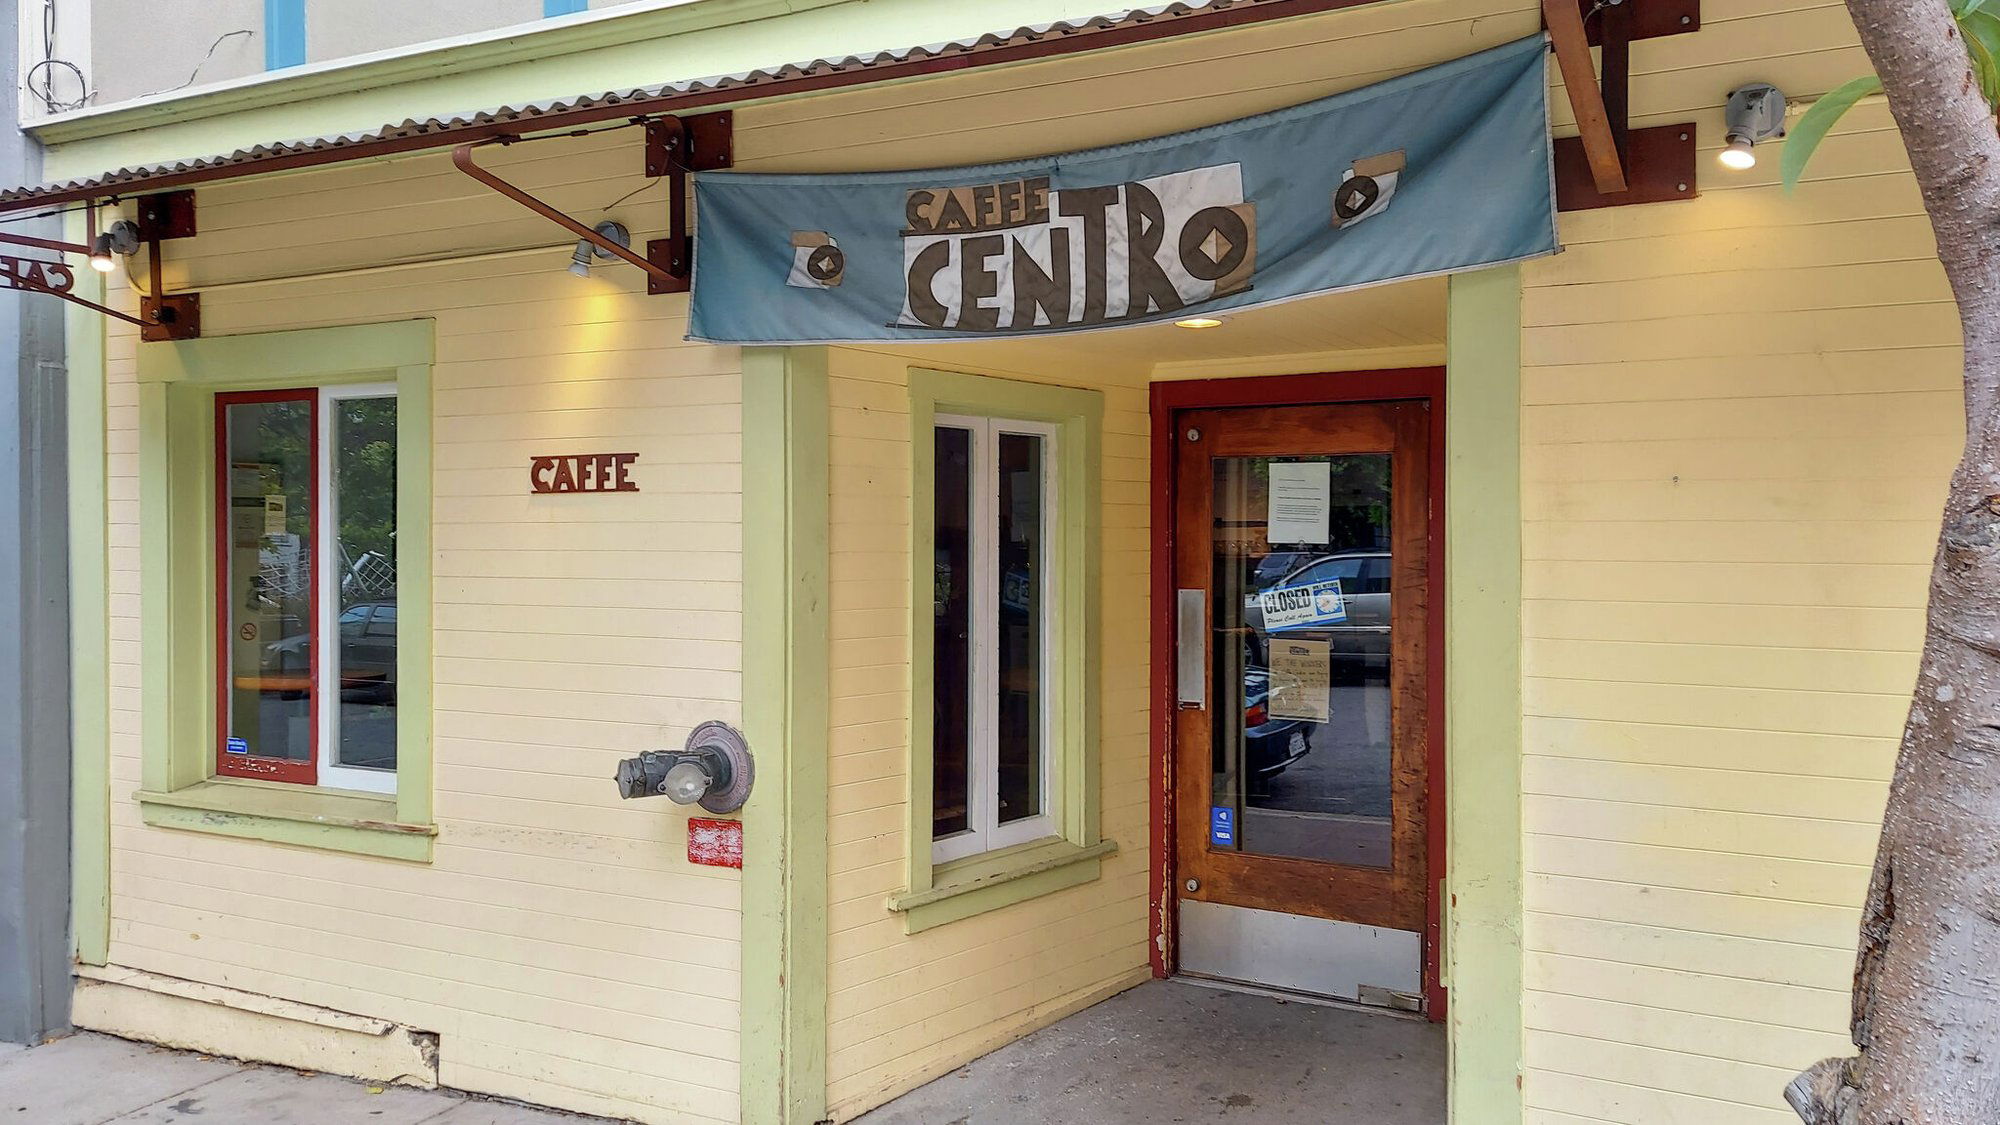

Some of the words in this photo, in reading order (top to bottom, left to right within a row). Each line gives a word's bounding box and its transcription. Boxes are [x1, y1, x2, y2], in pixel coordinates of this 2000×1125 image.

[905, 176, 1050, 233] CAFFE
[907, 182, 1249, 329] CENTRO
[531, 453, 639, 493] CAFFE
[1264, 588, 1311, 614] CLOSED
